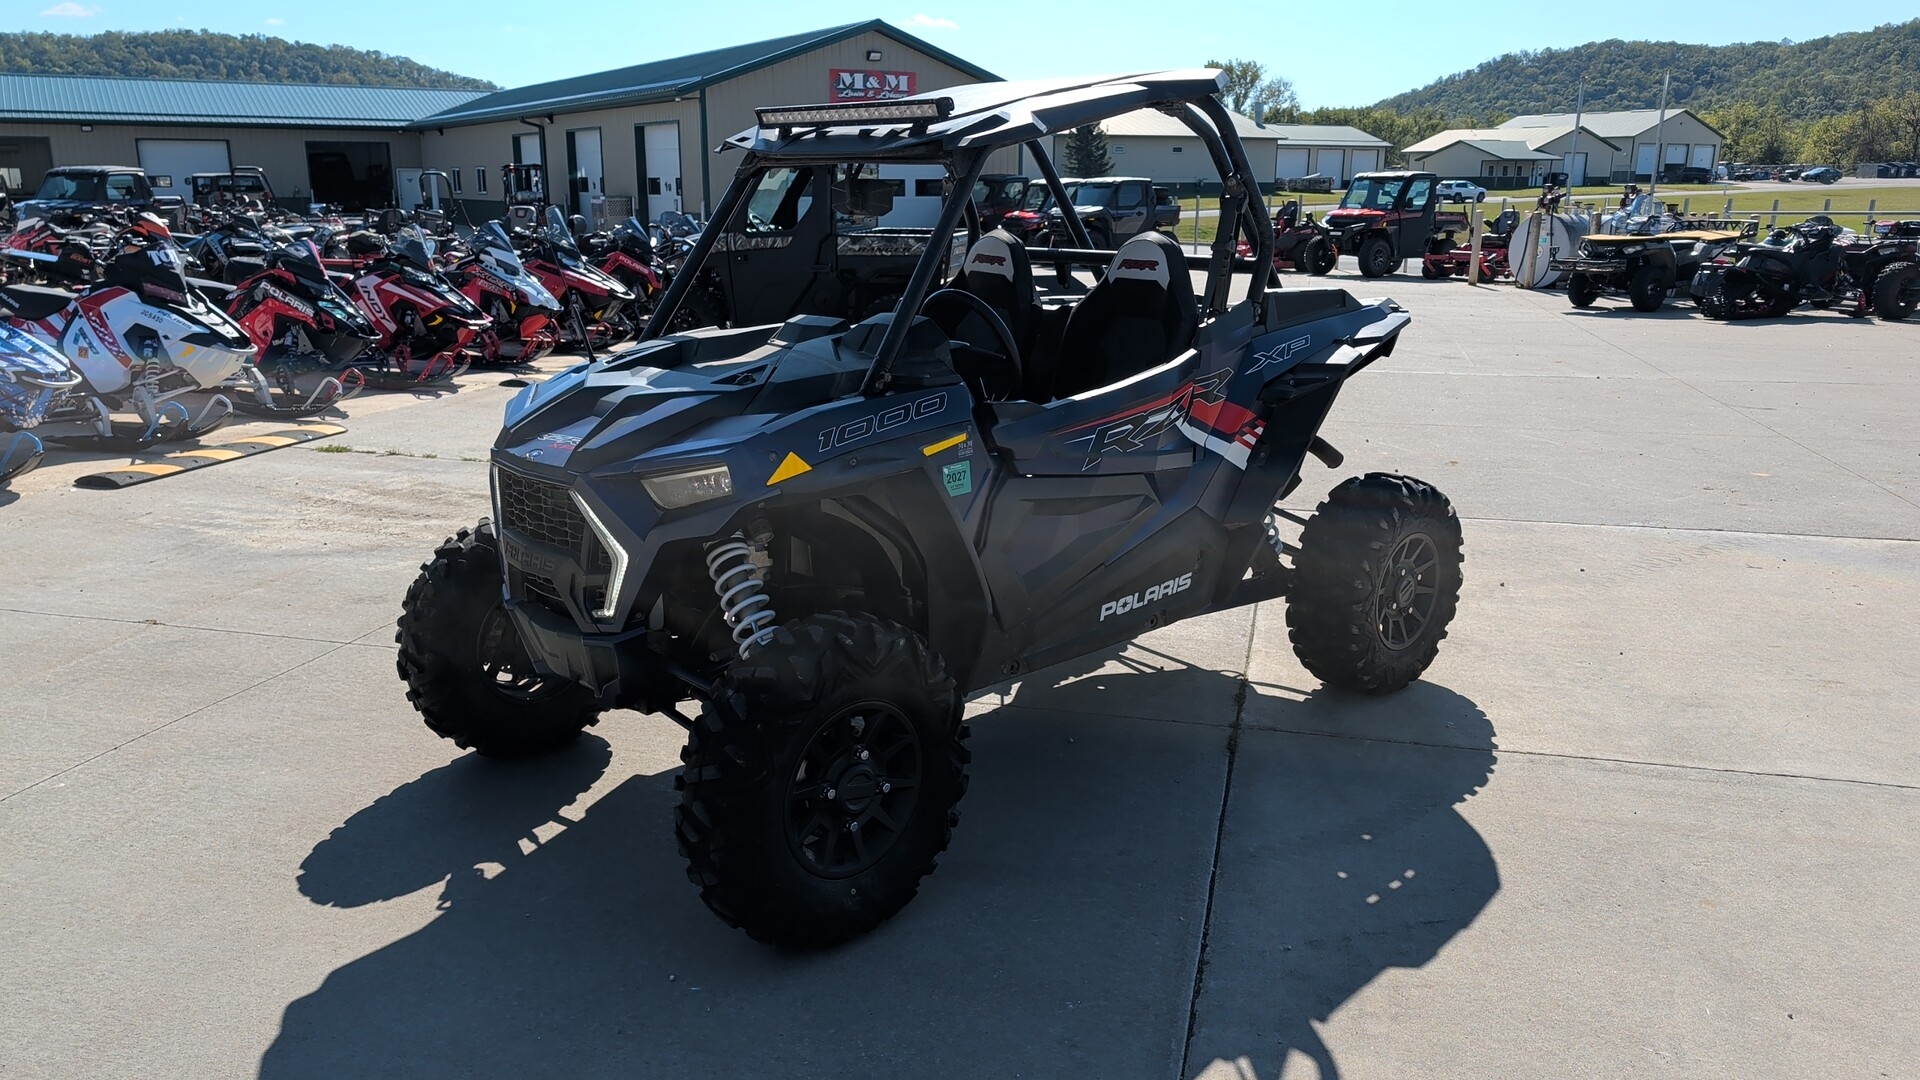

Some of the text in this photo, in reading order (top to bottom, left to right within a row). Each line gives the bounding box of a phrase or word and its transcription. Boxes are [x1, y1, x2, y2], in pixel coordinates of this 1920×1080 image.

[836, 72, 909, 92] M&M
[971, 253, 1007, 267] RZR
[1116, 258, 1160, 272] RZR
[260, 281, 315, 318] POLARIS
[360, 284, 393, 325] INDY
[1244, 334, 1311, 376] XP
[818, 391, 948, 453] 1000
[1081, 366, 1235, 472] RZR
[946, 470, 967, 484] 2027
[1100, 571, 1193, 622] POLARIS
